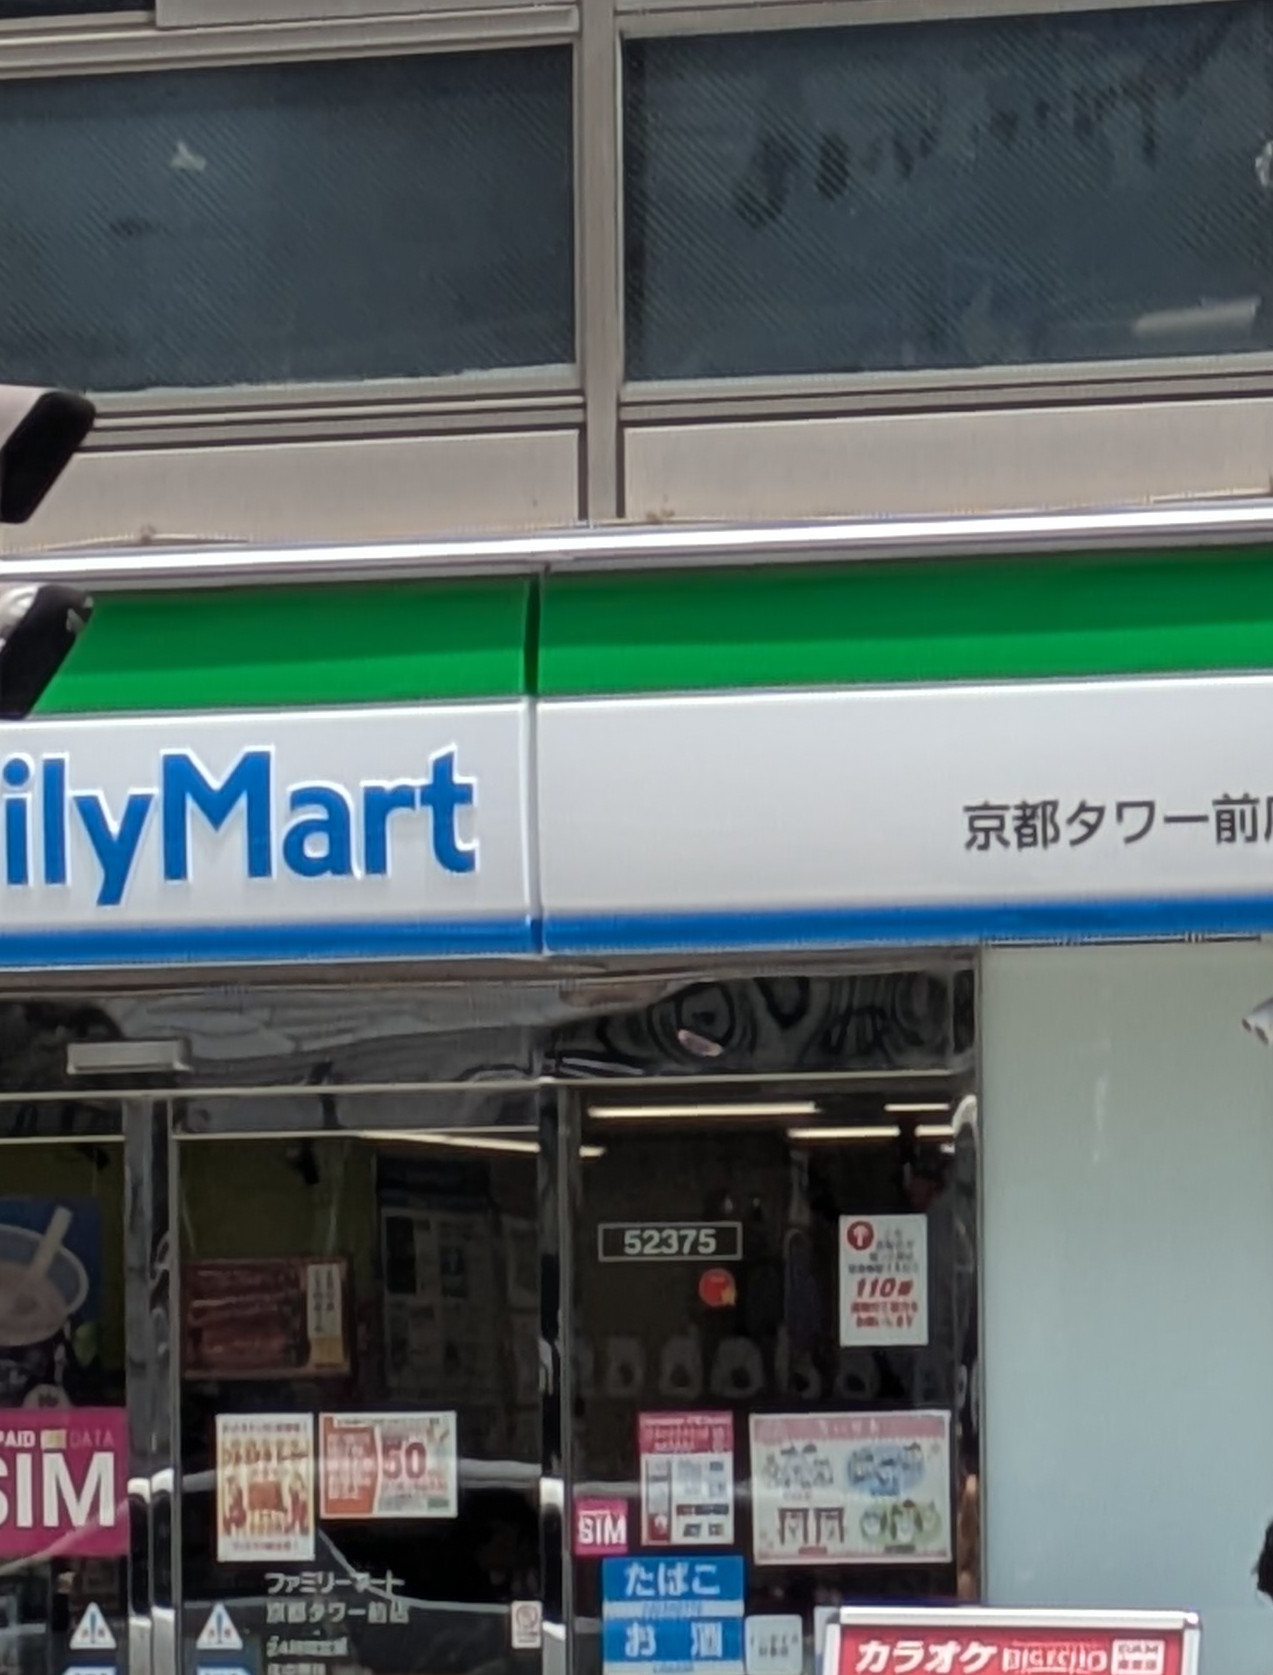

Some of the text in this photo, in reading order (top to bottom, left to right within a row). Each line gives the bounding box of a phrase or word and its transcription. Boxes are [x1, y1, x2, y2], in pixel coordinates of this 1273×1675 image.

[962, 793, 1273, 851] 京都タワー前
[624, 1229, 716, 1255] 52375
[578, 1515, 627, 1545] SIM
[624, 1562, 721, 1597] たばこ
[855, 1639, 998, 1674] カラオケ
